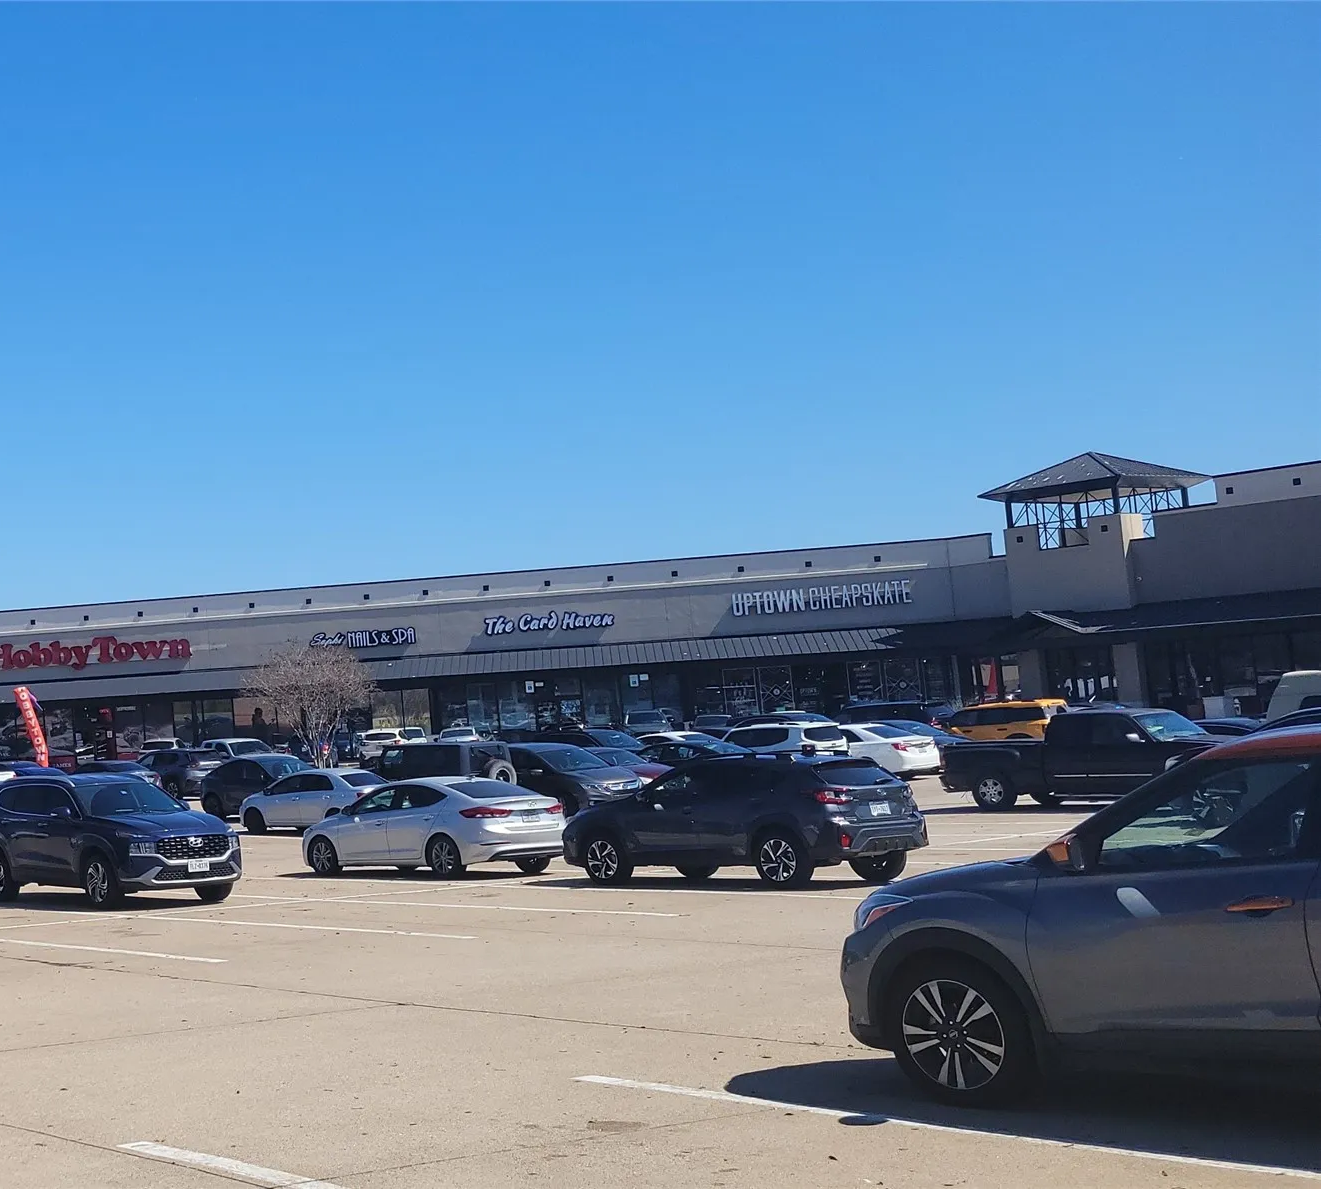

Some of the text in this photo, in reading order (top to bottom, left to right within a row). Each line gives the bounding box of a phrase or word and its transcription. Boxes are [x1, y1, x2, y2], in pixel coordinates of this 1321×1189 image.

[731, 580, 913, 617] UPTOWN CHEAPSKATE
[484, 611, 615, 635] The Card Haven
[346, 630, 379, 648] NAILS
[380, 632, 390, 644] &
[391, 627, 416, 645] SPA
